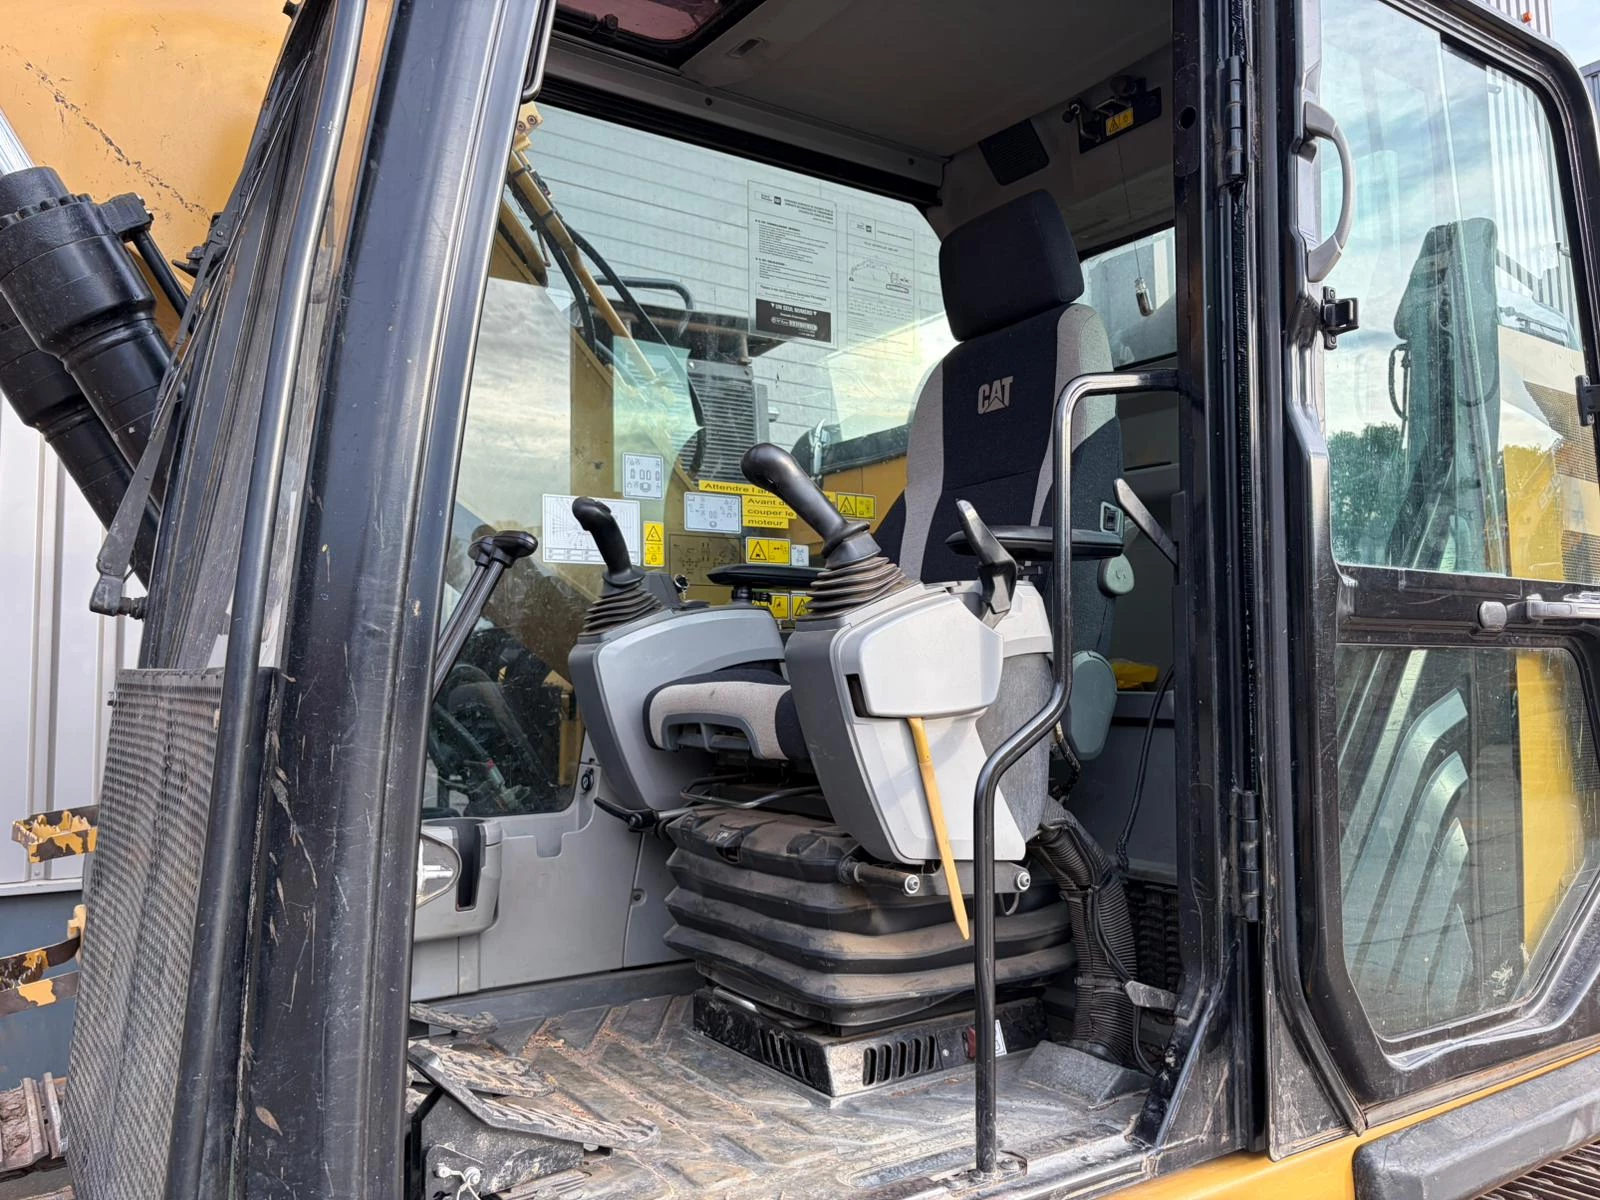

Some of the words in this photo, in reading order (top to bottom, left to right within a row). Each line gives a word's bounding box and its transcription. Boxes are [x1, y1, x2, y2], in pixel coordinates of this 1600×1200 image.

[978, 375, 1014, 415] CAT
[704, 482, 750, 494] Attendre
[747, 498, 776, 506] Avant
[747, 508, 783, 517] couper
[747, 518, 784, 527] moteur
